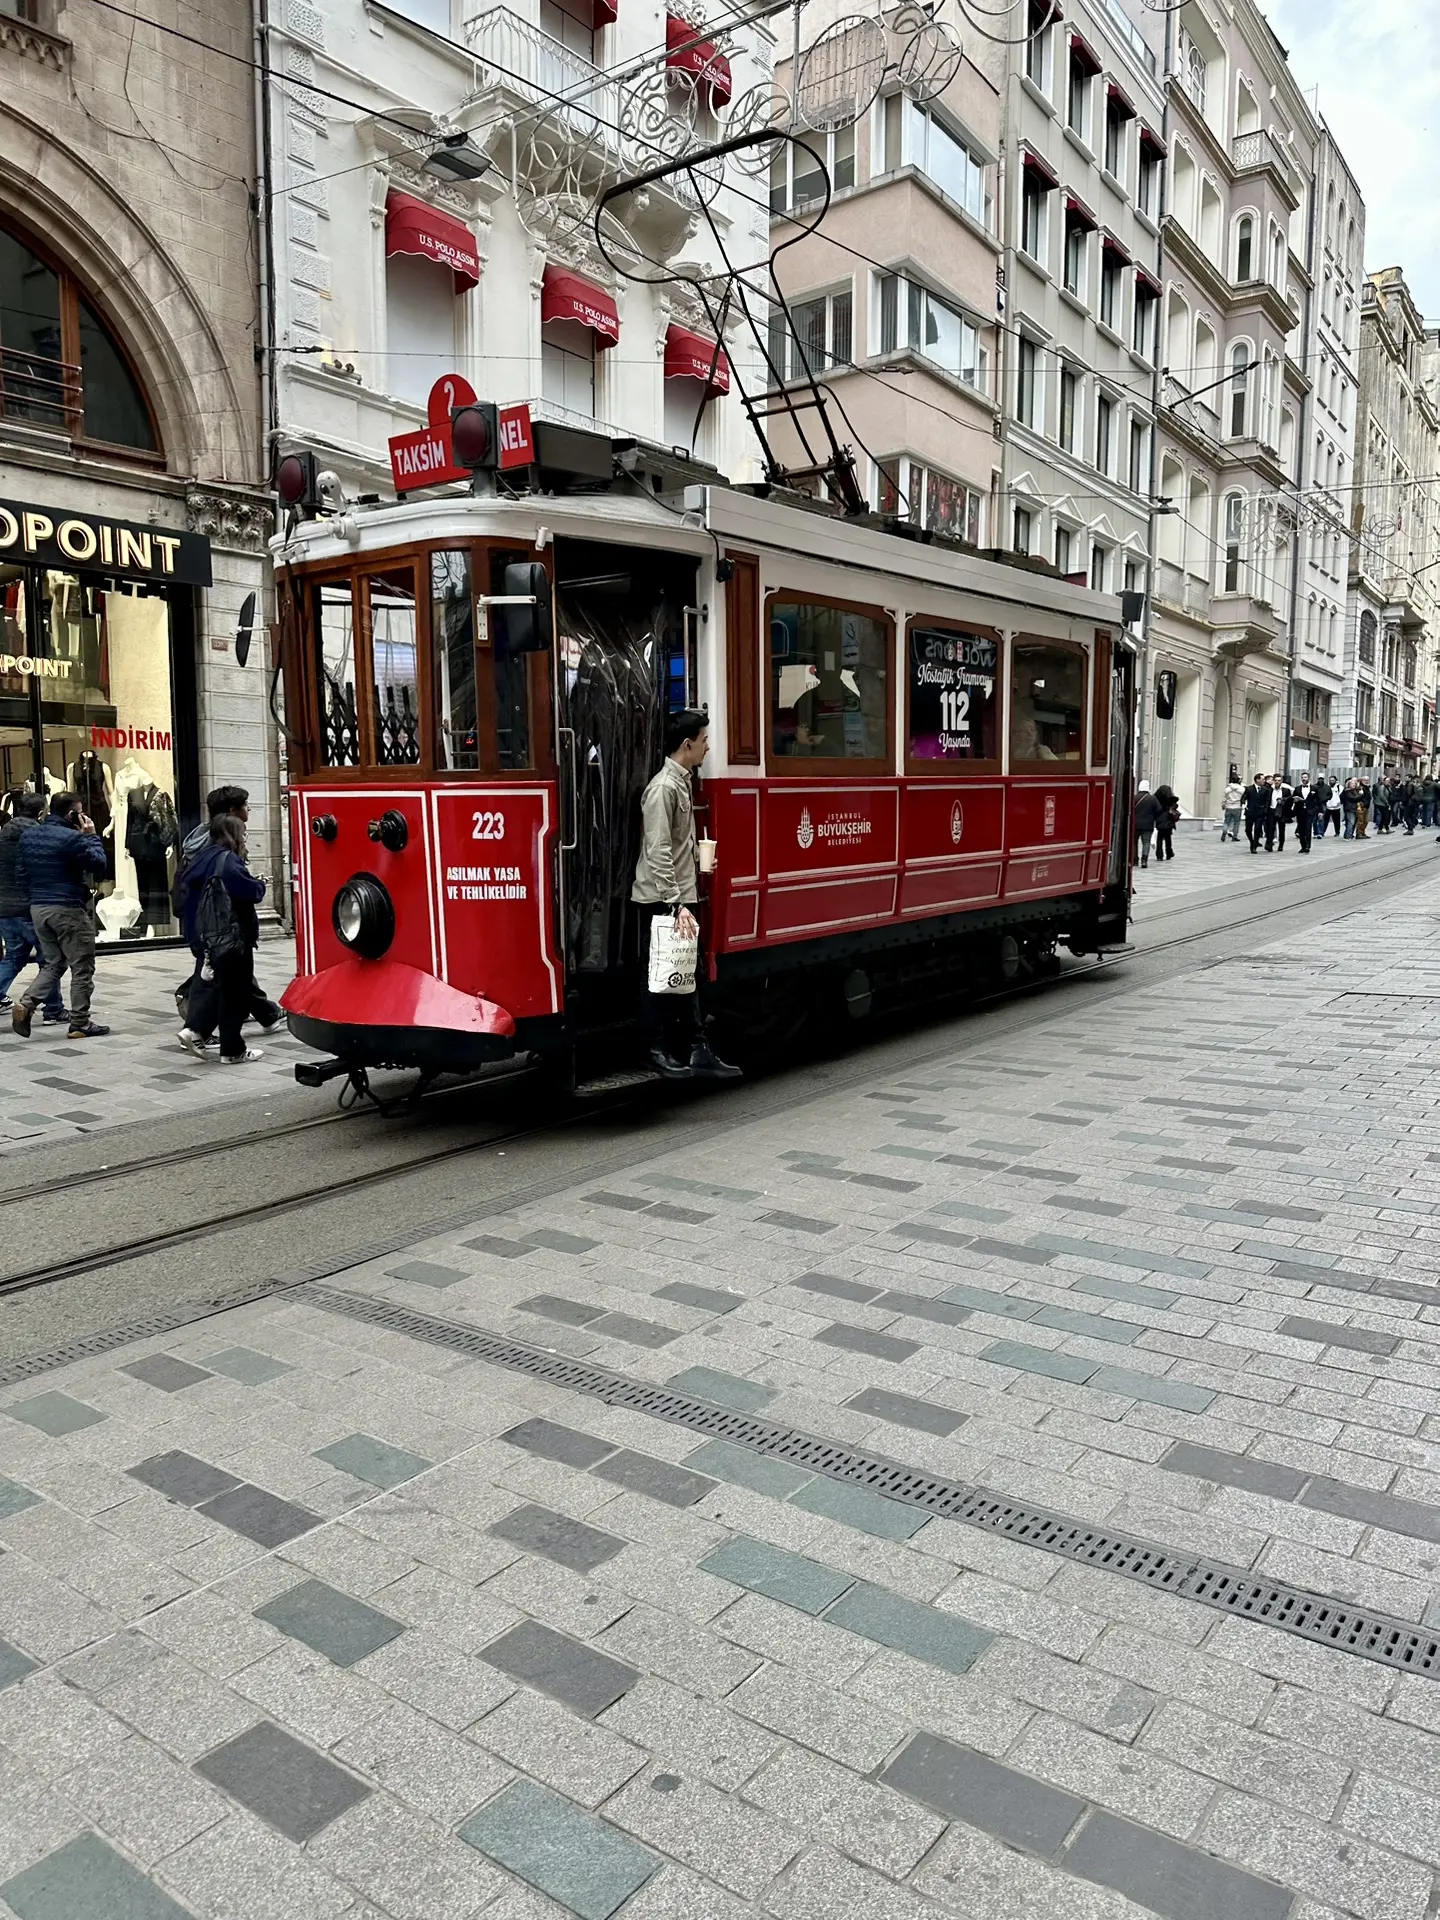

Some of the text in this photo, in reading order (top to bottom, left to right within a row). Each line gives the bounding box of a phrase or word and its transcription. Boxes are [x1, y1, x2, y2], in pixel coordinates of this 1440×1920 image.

[418, 233, 435, 249] U.S.
[434, 240, 456, 258] POLO
[573, 300, 585, 314] U.S.
[584, 306, 601, 321] POLO
[394, 418, 528, 476] TAKSİM NEL
[0, 653, 73, 678] POINT
[917, 661, 954, 690] Nostaljik
[939, 690, 970, 731] 112
[91, 720, 172, 751] İNDİRİM
[938, 732, 971, 753] Yaşında
[471, 811, 505, 840] 223
[817, 817, 872, 838] BÜYÜKŞEHİR
[446, 866, 521, 881] ASILMAK YASA
[446, 882, 527, 900] VE TEHLİKELİDİR
